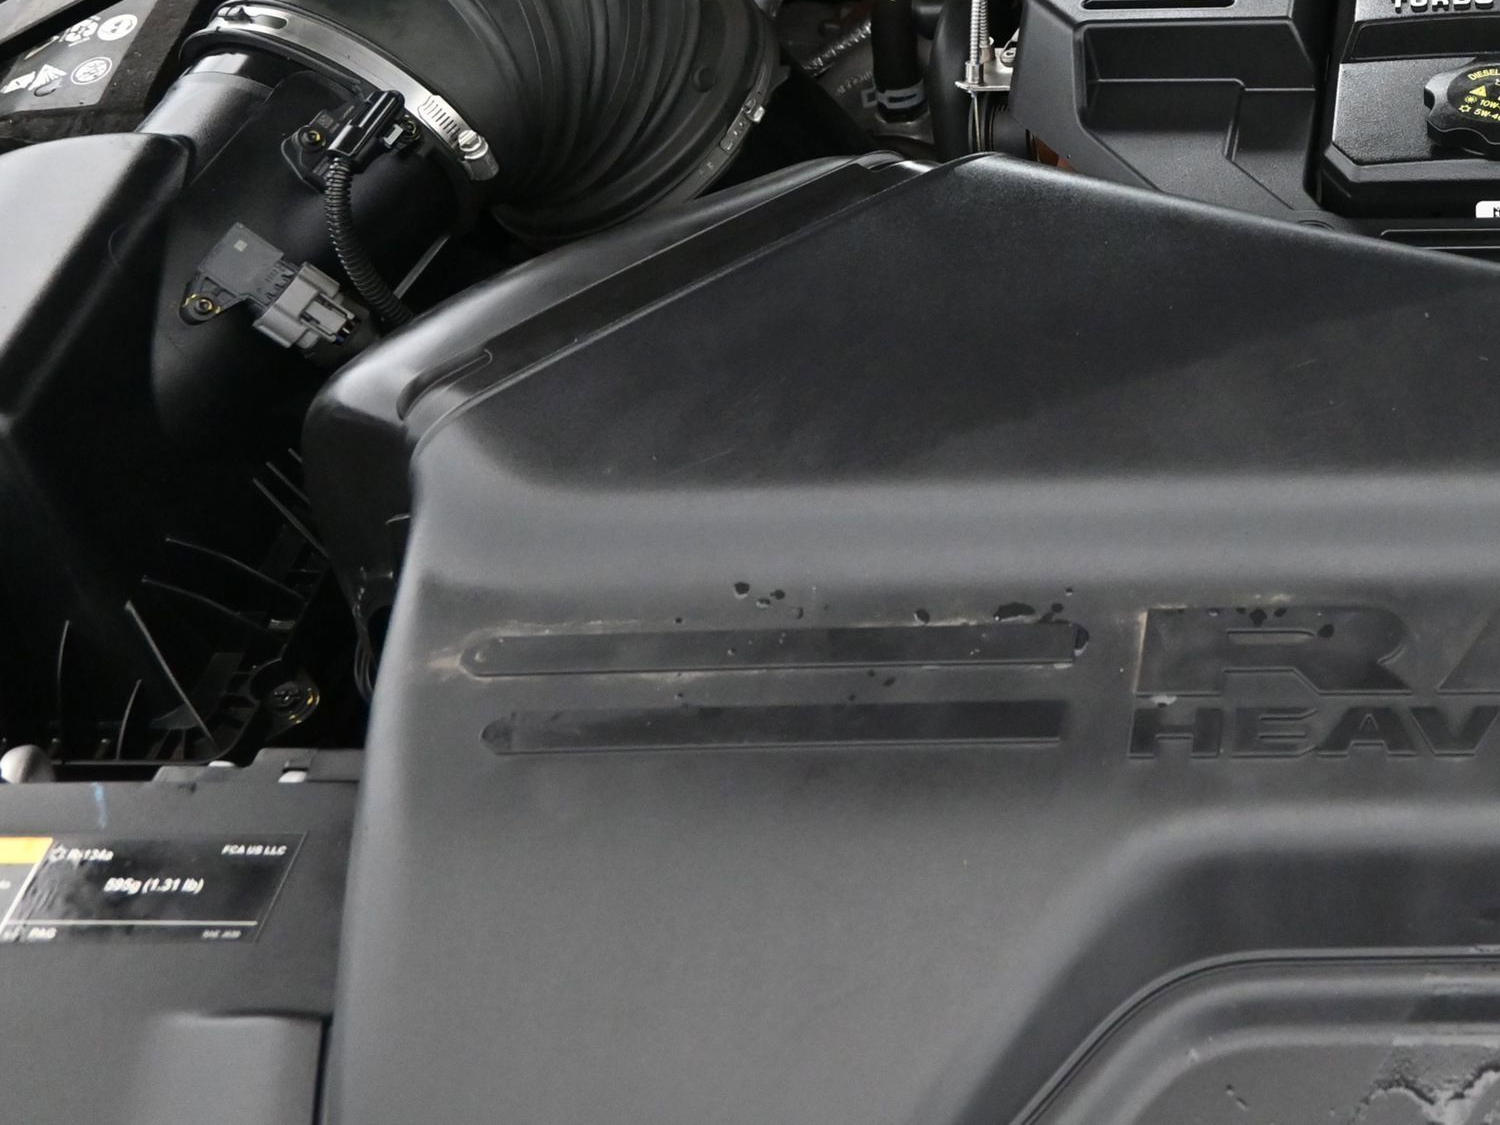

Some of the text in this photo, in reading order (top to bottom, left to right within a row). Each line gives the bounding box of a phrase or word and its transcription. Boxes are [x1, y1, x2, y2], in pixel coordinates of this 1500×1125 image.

[1467, 68, 1500, 81] DIESEL
[221, 844, 288, 856] FCA US LLC
[141, 877, 181, 894] (1.31
[181, 877, 205, 895] lb)
